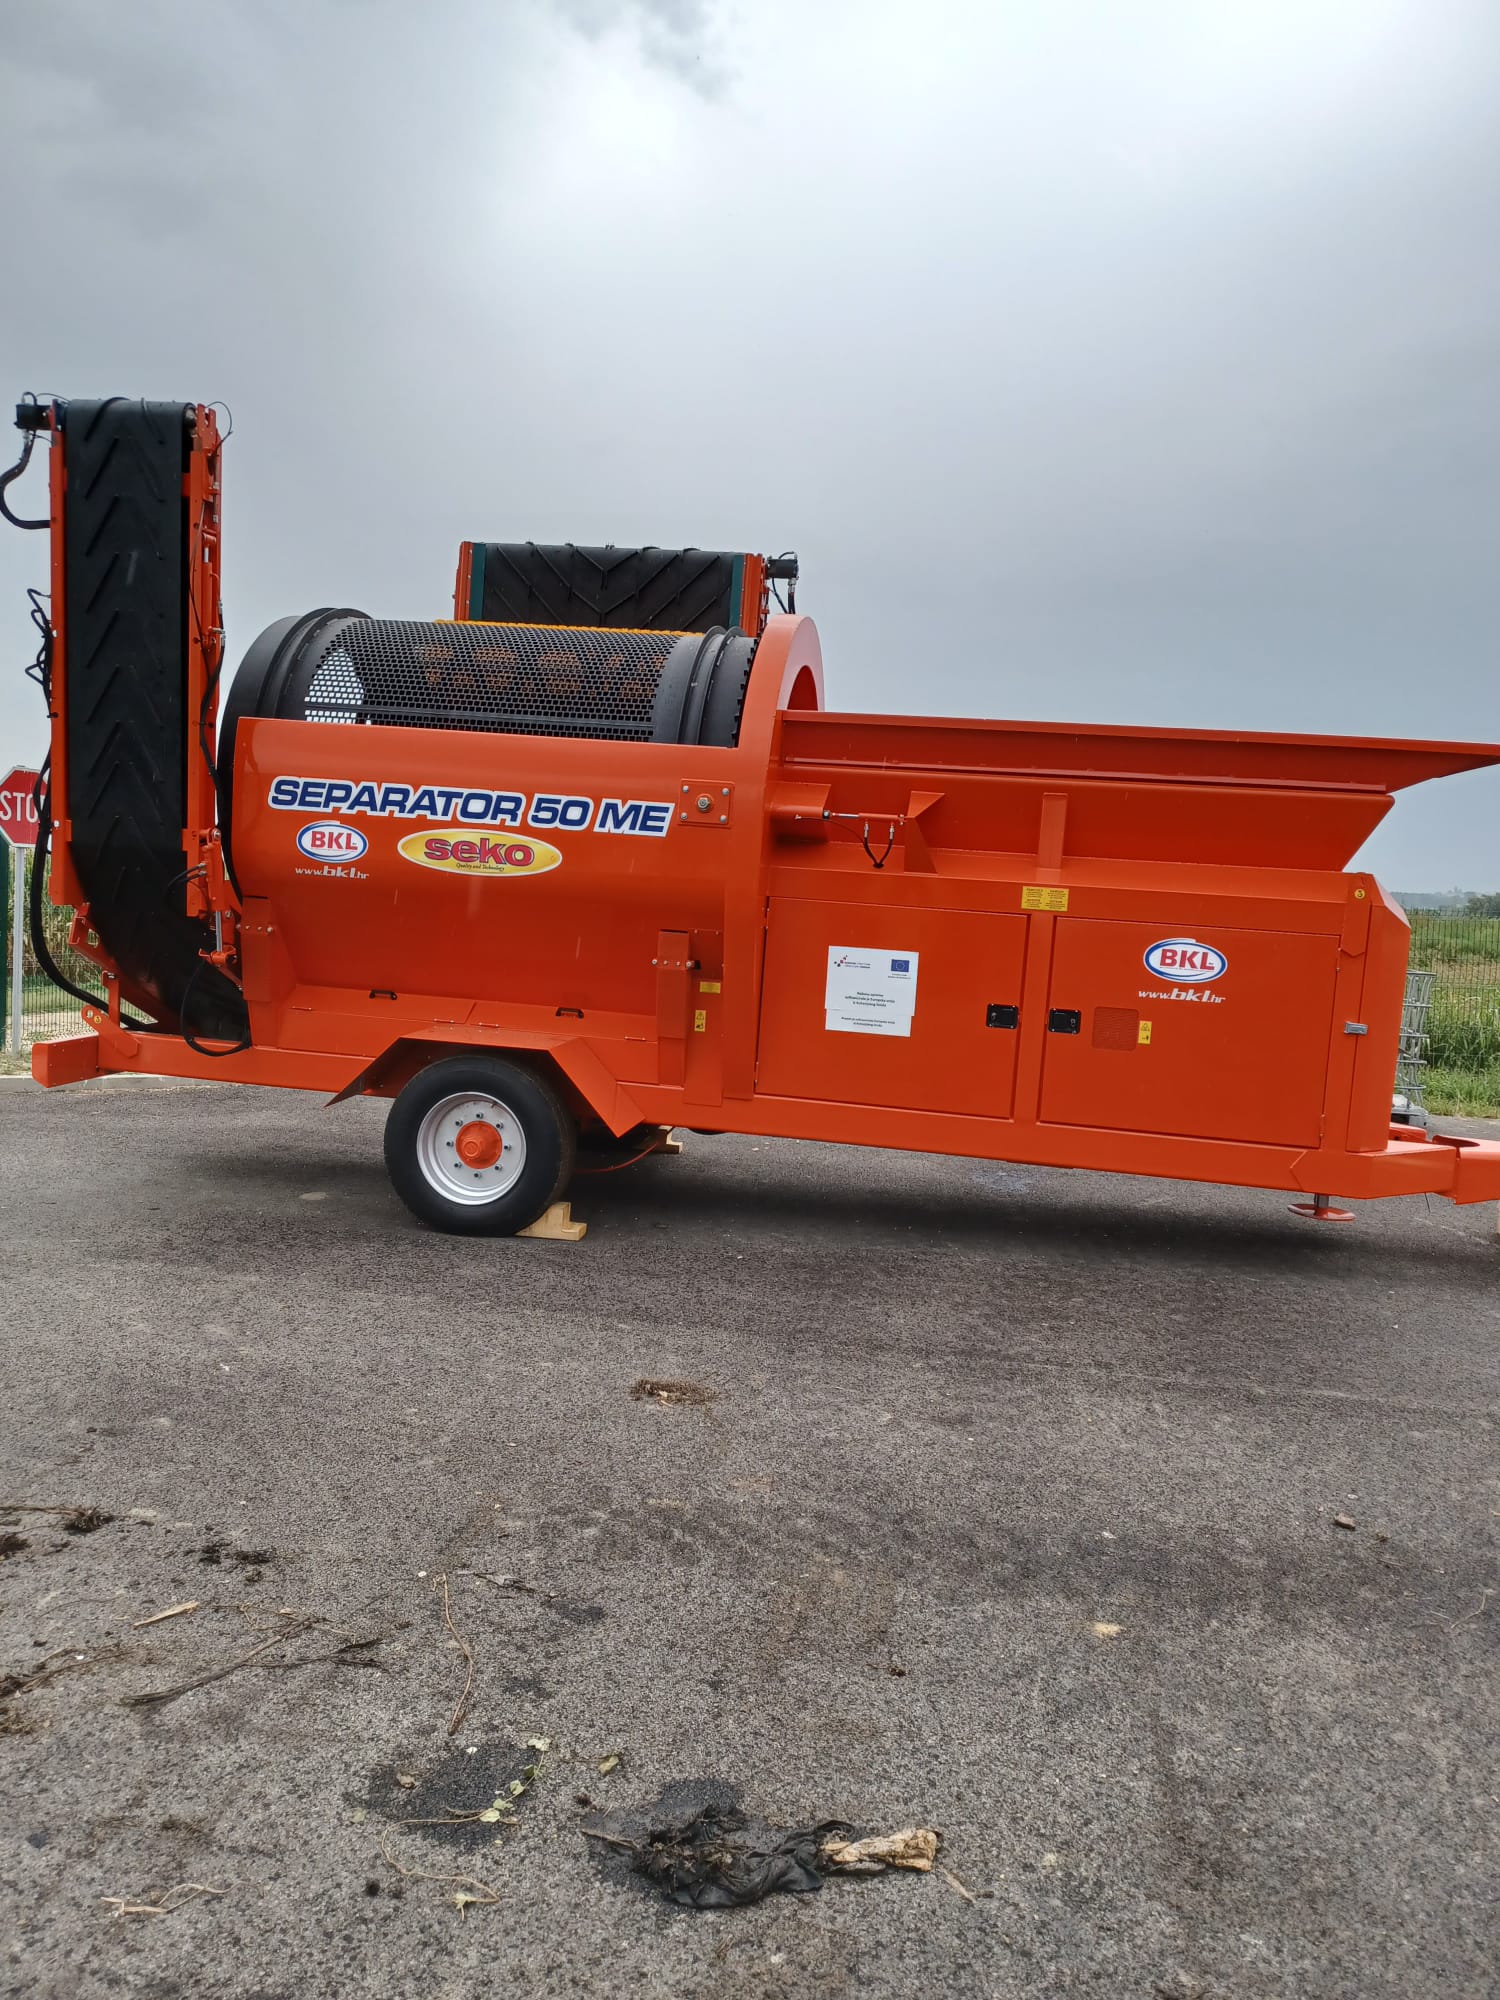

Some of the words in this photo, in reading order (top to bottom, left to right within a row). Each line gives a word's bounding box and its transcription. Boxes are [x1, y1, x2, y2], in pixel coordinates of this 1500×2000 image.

[0, 790, 45, 823] STO
[270, 778, 524, 823] SEPARATOR
[530, 797, 591, 828] 50
[597, 802, 671, 833] ME
[310, 830, 359, 851] BKL
[424, 838, 535, 866] seko
[294, 865, 370, 880] www.bkl.hr
[1159, 948, 1216, 971] BKL
[1137, 987, 1227, 1004] www.bkl.hr
